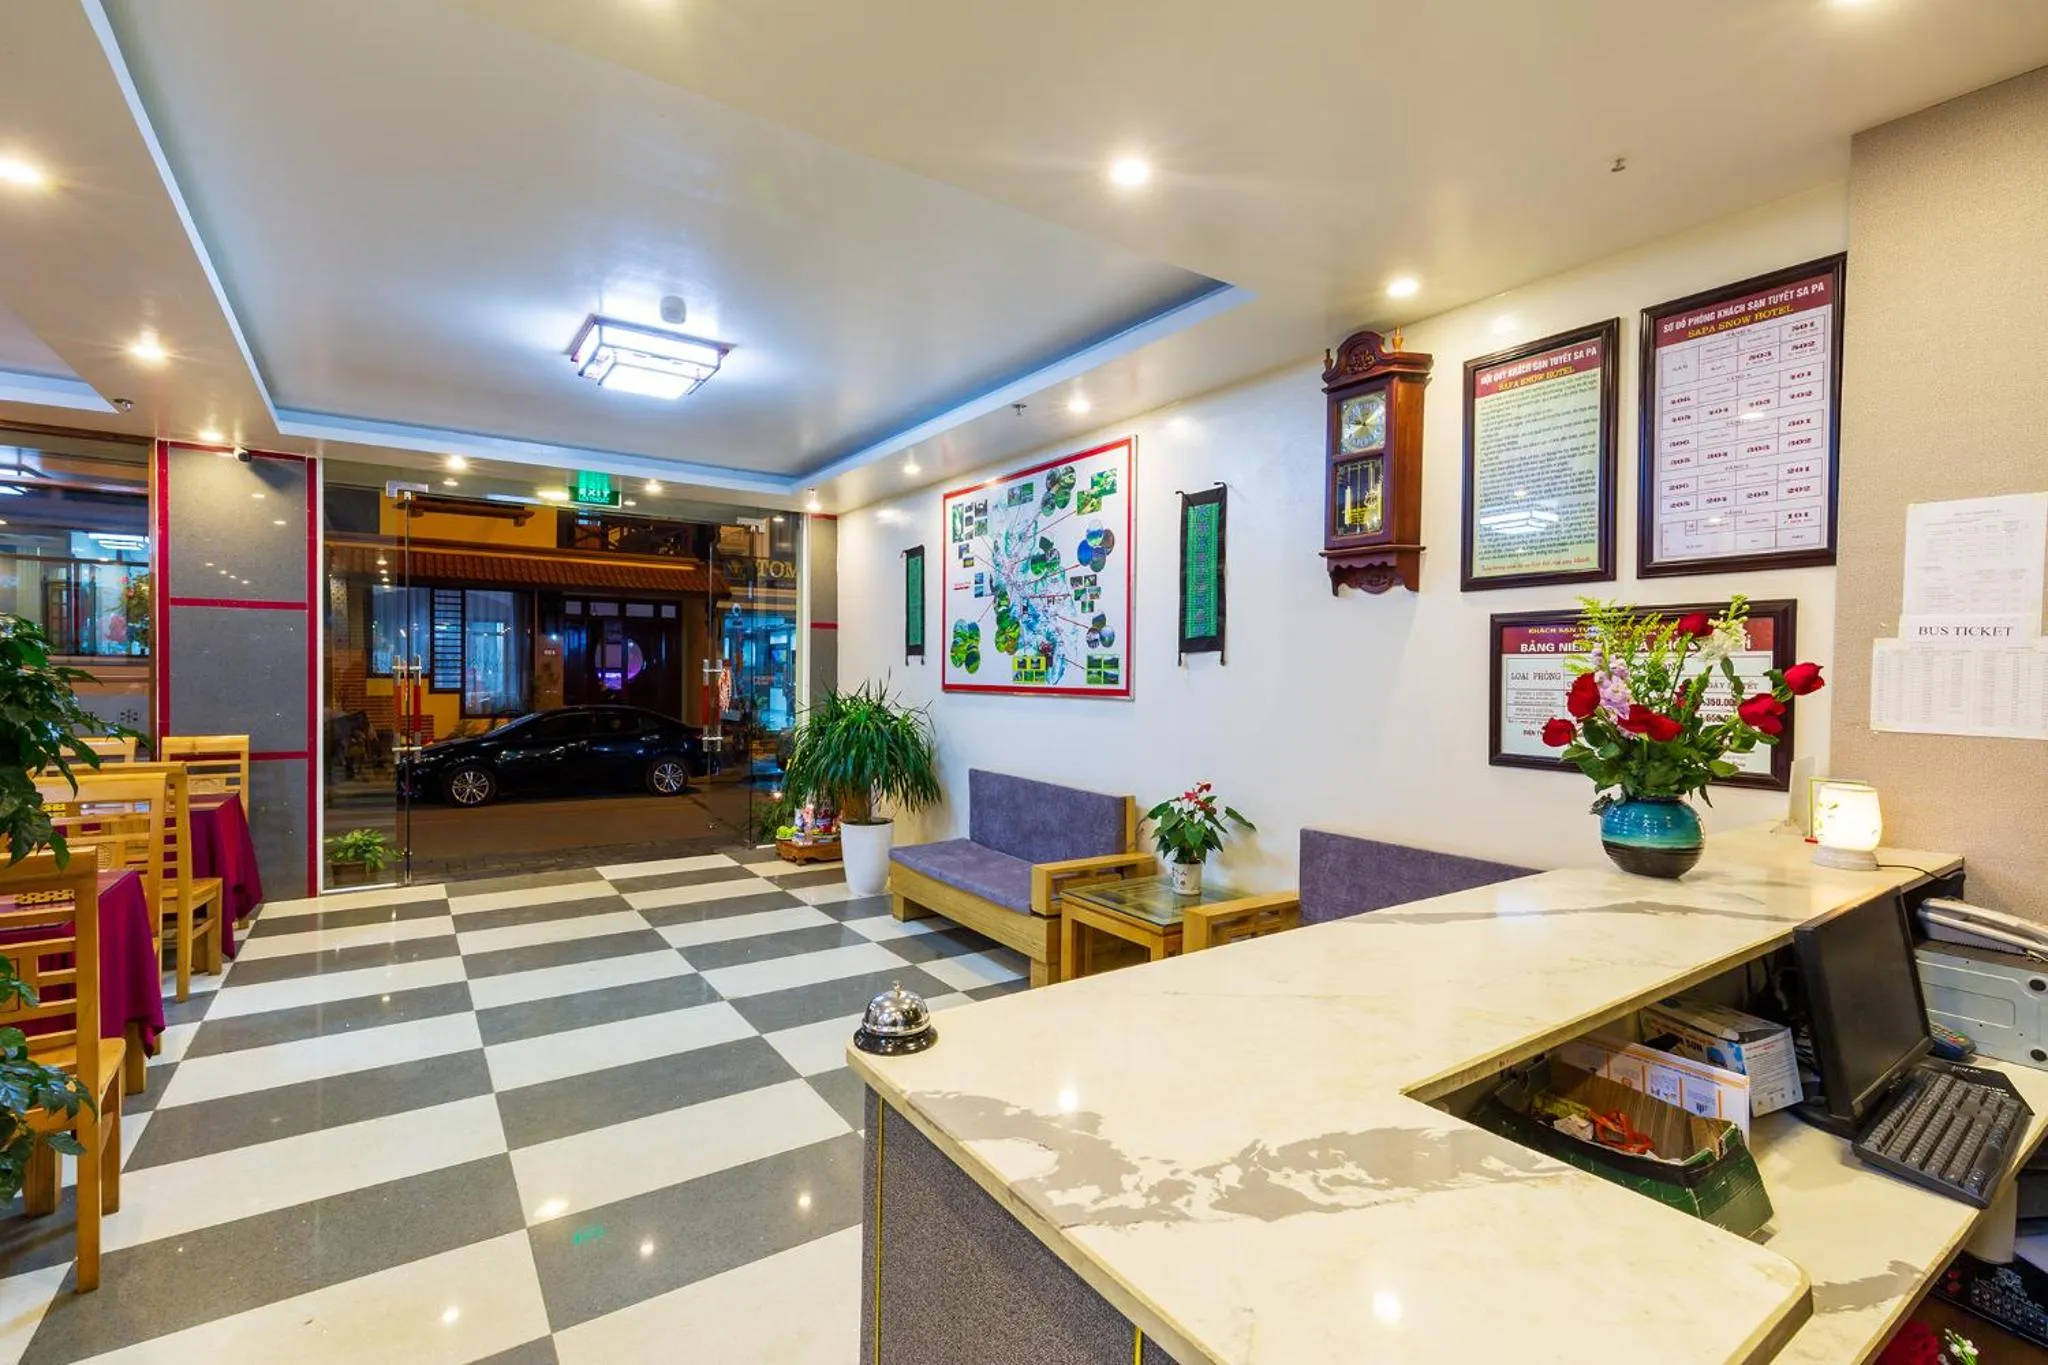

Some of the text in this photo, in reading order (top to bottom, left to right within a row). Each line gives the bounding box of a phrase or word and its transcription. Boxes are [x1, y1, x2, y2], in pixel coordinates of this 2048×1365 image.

[1716, 303, 1746, 320] KHÁCH
[1747, 298, 1767, 311] SẠN
[1767, 289, 1796, 306] TUYẾT
[1796, 285, 1810, 297] SA
[1811, 281, 1825, 294] PA
[1687, 325, 1717, 339] SAPA
[1718, 316, 1751, 330] SNOW
[1754, 304, 1794, 321] HOTEL
[1573, 349, 1585, 360] SA
[1586, 346, 1597, 357] PA
[1498, 380, 1519, 392] SAPA
[1546, 364, 1576, 379] HOTEL
[579, 487, 611, 498] EXIT
[1918, 625, 2013, 637] BUS TICKET
[1520, 639, 1555, 653] BẢNG
[1532, 669, 1562, 681] PHÒNG
